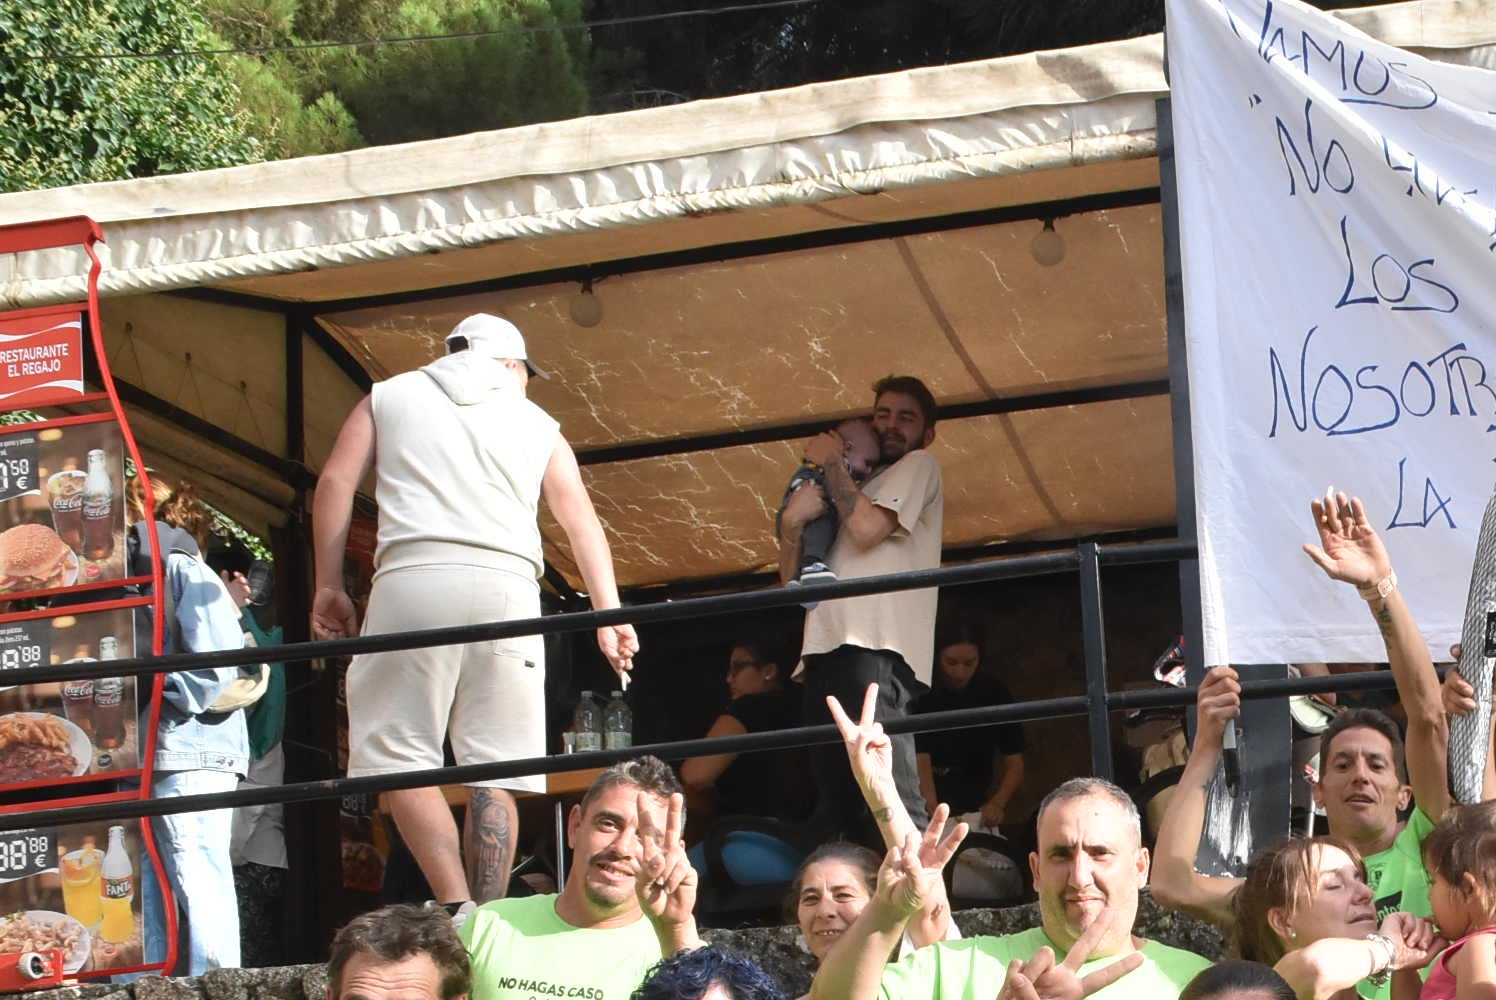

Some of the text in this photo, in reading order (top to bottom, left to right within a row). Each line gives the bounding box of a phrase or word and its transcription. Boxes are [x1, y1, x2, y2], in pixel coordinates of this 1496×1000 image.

[1334, 216, 1460, 314] LOS
[0, 344, 69, 363] RESTAURANTE
[8, 359, 61, 378] EL REGAJO
[1387, 457, 1457, 532] LA
[498, 977, 604, 1000] NO HAGAS CASO
